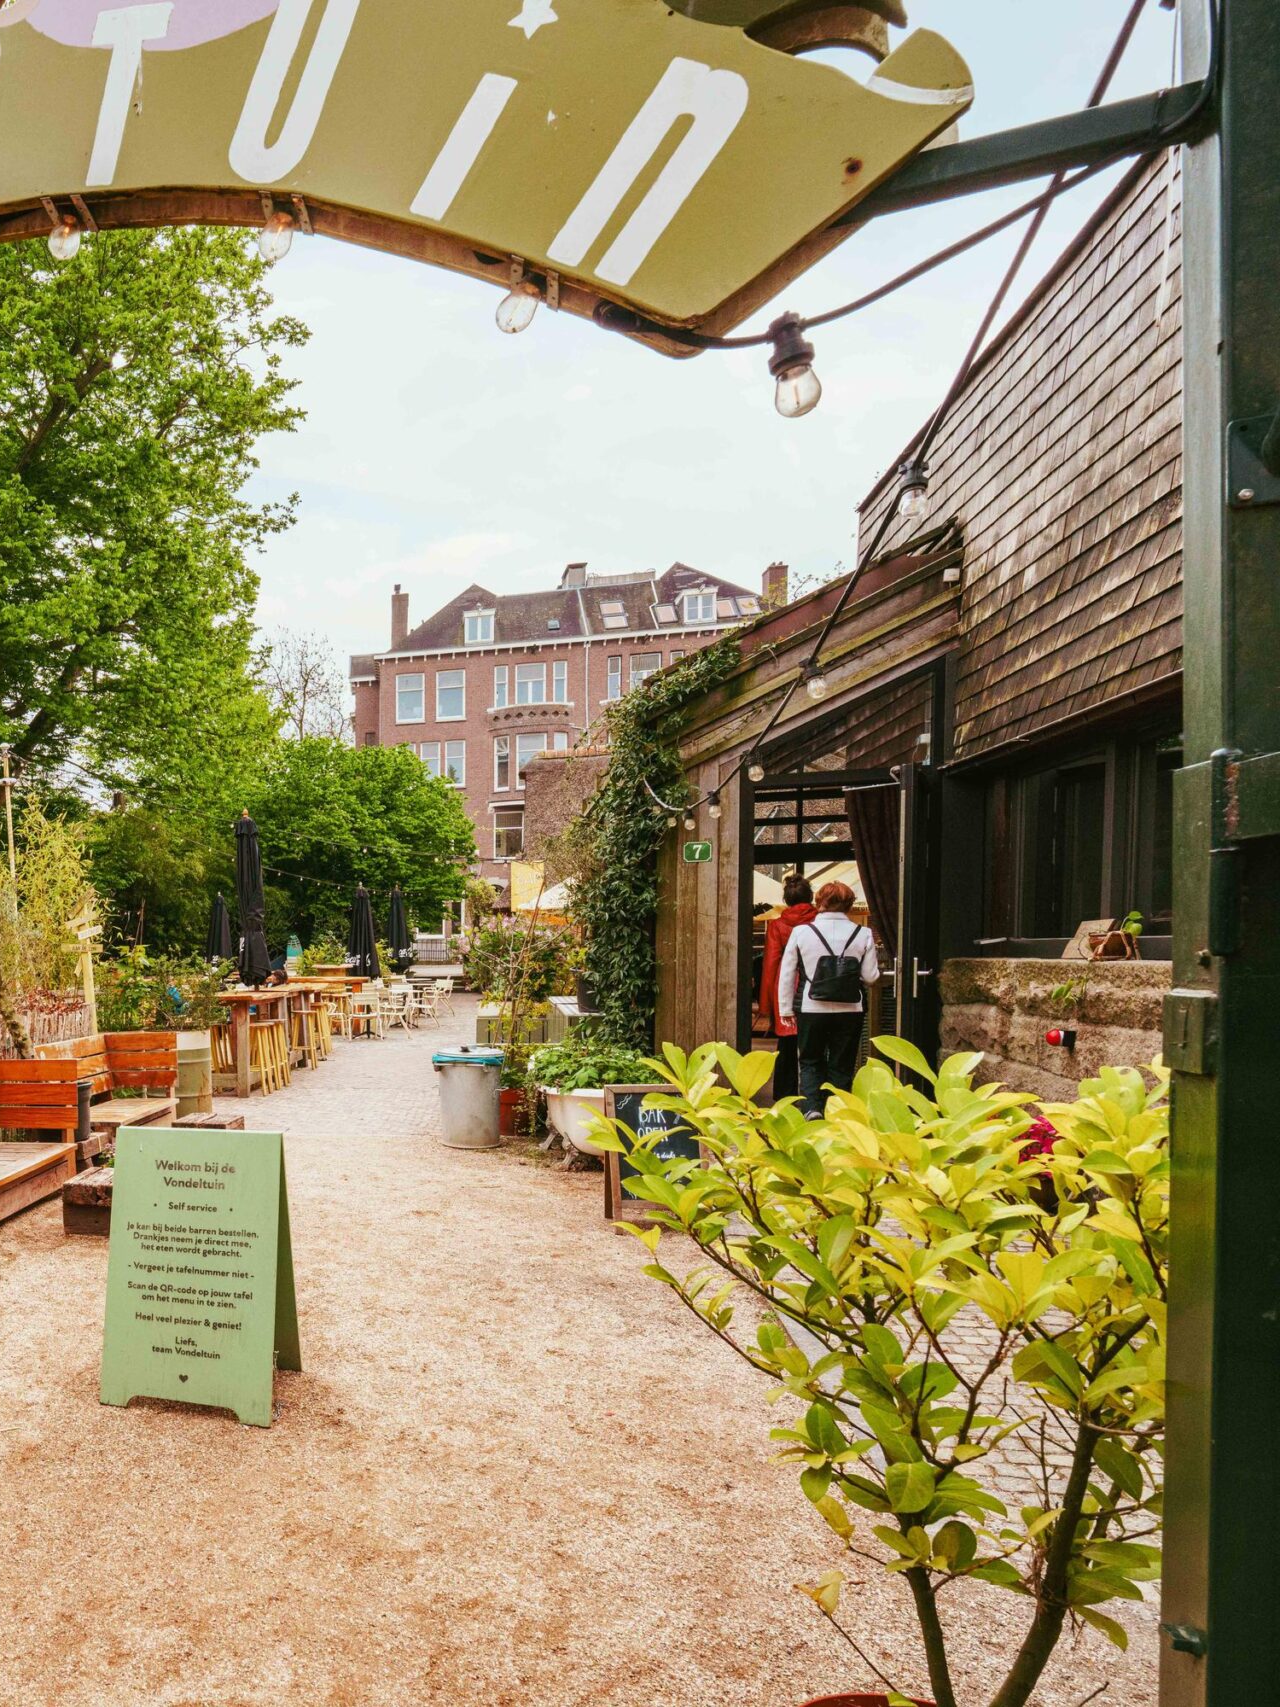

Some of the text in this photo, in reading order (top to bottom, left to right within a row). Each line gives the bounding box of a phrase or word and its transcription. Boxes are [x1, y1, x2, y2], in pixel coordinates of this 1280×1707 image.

[693, 845, 702, 859] 7
[639, 1106, 666, 1123] BAR
[155, 1160, 235, 1175] Welkom bij de
[164, 1177, 225, 1190] Vondeltuin
[169, 1202, 217, 1212] Self service
[127, 1222, 134, 1230] Je
[153, 1223, 162, 1233] bij
[164, 1224, 186, 1233] beide
[189, 1226, 216, 1235] barren
[219, 1229, 259, 1238] bestellen.
[133, 1232, 169, 1243] Drankjes
[195, 1236, 202, 1246] je
[204, 1238, 228, 1247] direct
[176, 1246, 200, 1255] wordt
[203, 1248, 242, 1258] gebracht.
[134, 1262, 164, 1273] Vergeet
[166, 1263, 173, 1273] je
[176, 1266, 228, 1278] tafelnummer
[232, 1270, 248, 1279] niet
[128, 1281, 253, 1300] Scan de QR-code op jouw tafel
[156, 1293, 170, 1303] het
[172, 1296, 195, 1305] menu
[197, 1296, 204, 1306] in
[217, 1300, 236, 1309] zien.
[136, 1312, 241, 1330] Heel veel plezier & geniet!
[175, 1336, 197, 1347] Liefs,
[152, 1345, 220, 1360] team Vondeltuin
